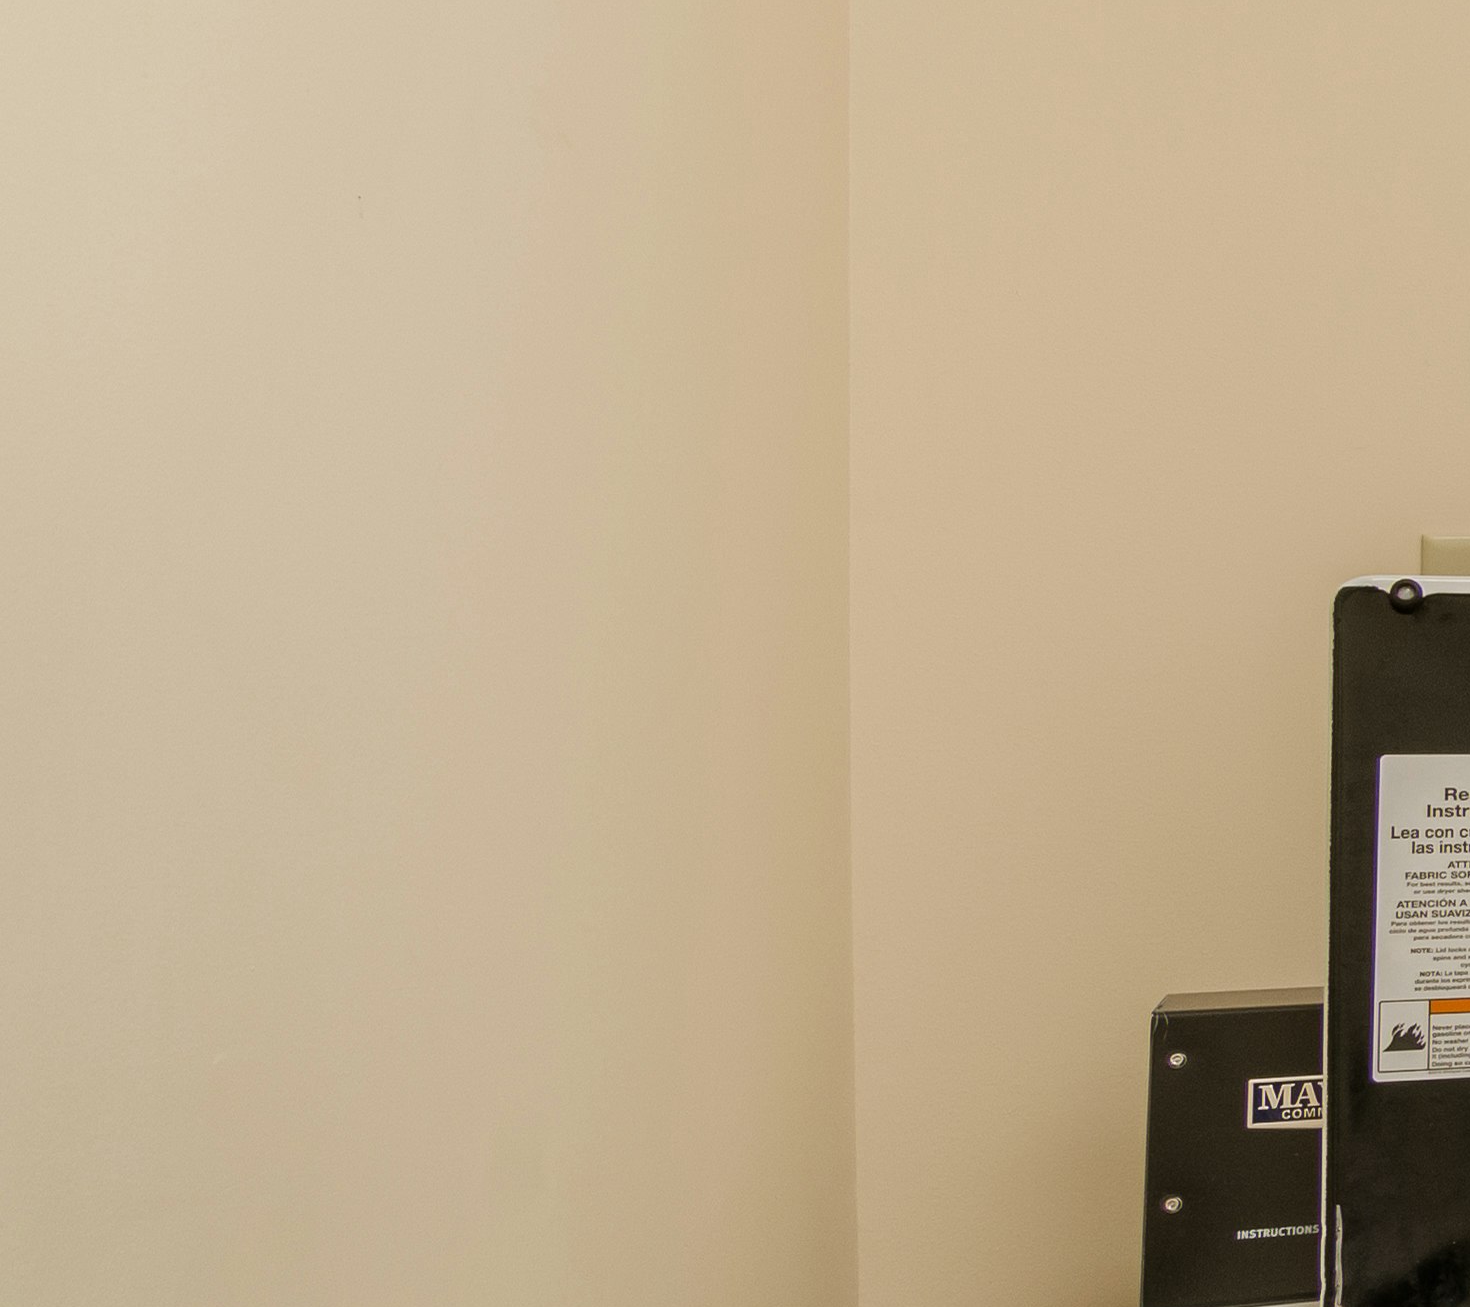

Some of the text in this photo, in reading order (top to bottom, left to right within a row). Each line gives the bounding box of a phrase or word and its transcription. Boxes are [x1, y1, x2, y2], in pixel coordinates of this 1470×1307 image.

[1391, 826, 1419, 839] Lea
[1425, 828, 1454, 839] con
[1411, 841, 1434, 854] las
[1404, 871, 1447, 880] FABRIC
[1396, 897, 1456, 909] ATENCIÓN
[1459, 899, 1468, 907] A
[1395, 910, 1428, 919] USAN
[1257, 1081, 1323, 1110] MA
[1237, 1224, 1320, 1240] INSTRUCTIONS
